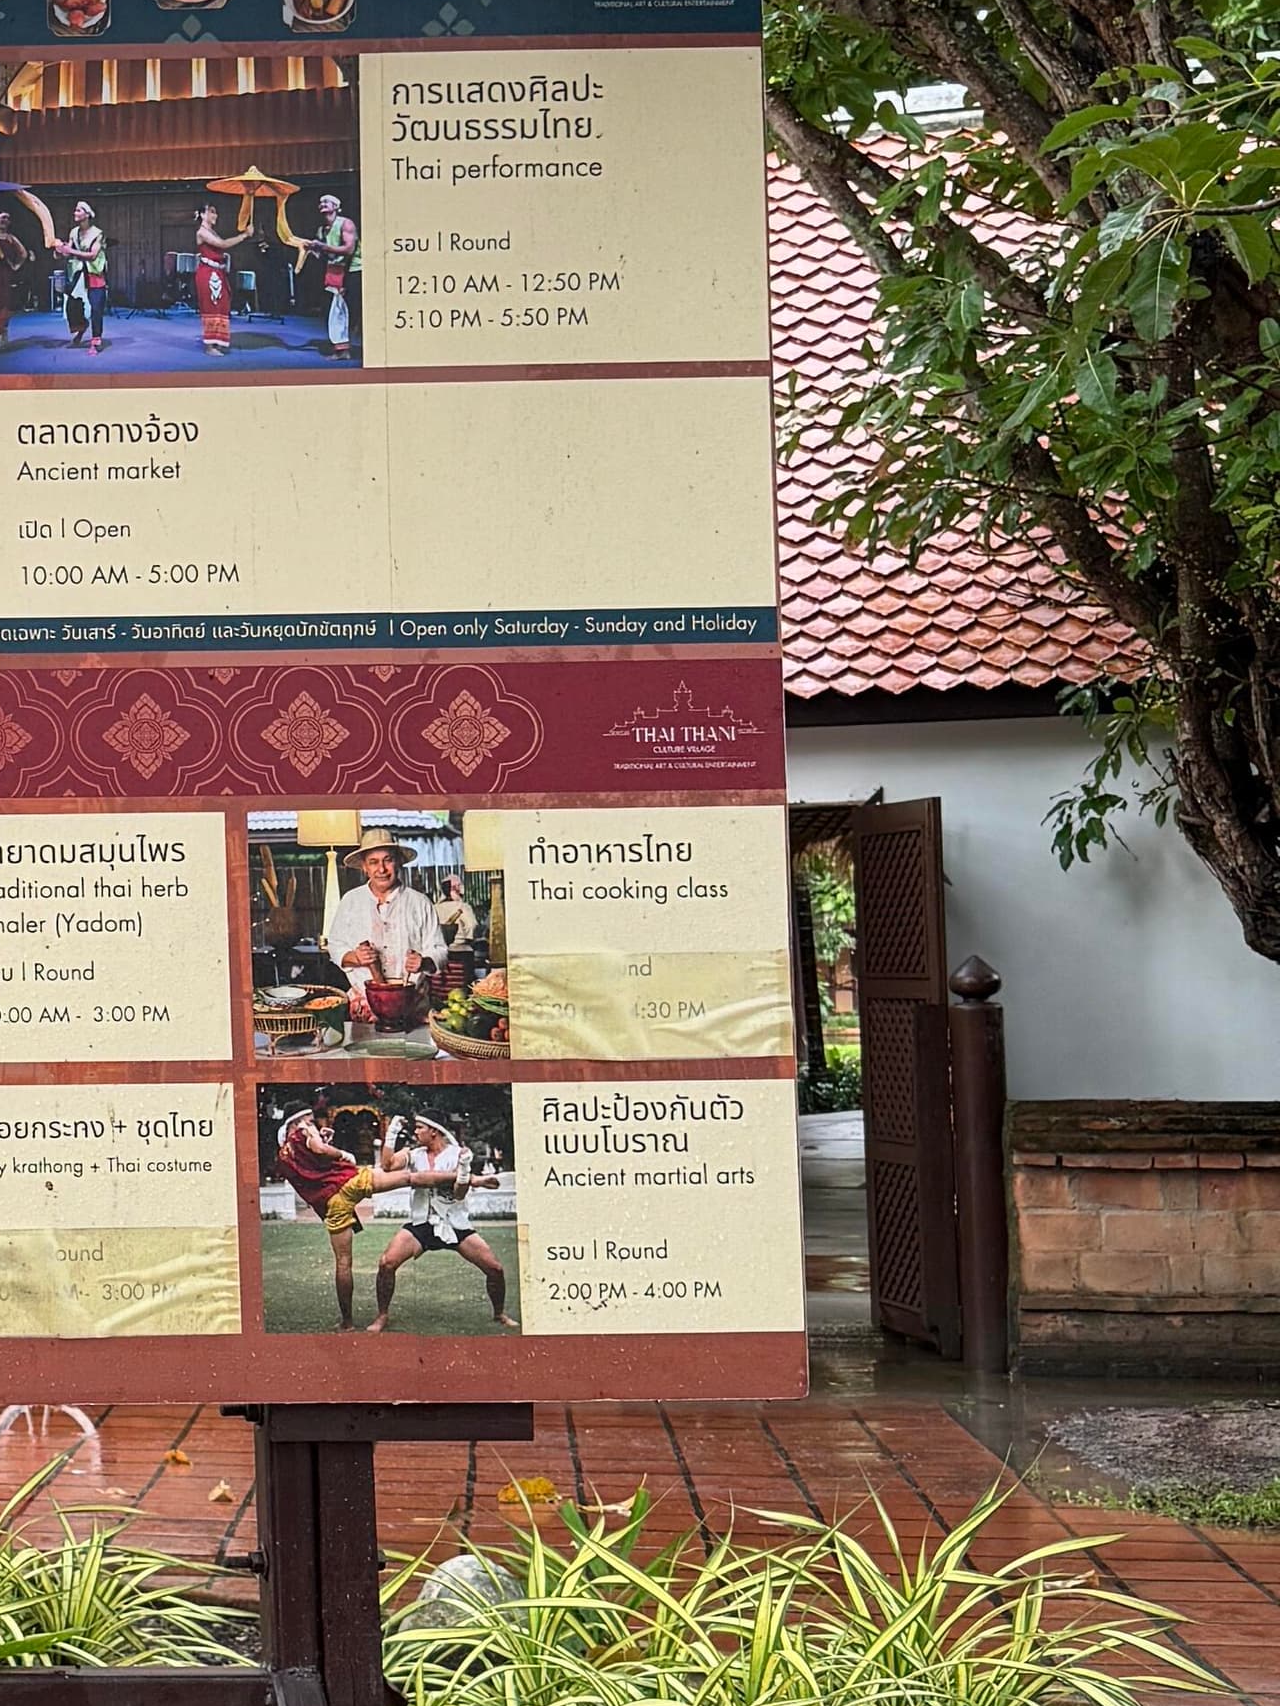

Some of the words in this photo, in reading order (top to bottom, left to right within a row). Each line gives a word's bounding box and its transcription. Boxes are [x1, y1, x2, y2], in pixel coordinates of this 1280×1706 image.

[393, 73, 603, 105] การแสดงศิลปะ
[392, 108, 591, 141] วัฒนธรรมไทย
[391, 156, 440, 180] Thai
[453, 154, 602, 186] performance
[18, 414, 198, 444] ตลาดกางจ้อง
[17, 461, 98, 480] Ancient
[108, 457, 180, 479] market
[62, 624, 116, 640] วันเสาร์
[132, 624, 204, 638] วันอาทิตย์
[401, 620, 446, 640] Open
[453, 618, 488, 639] only
[495, 617, 568, 637] Saturday
[586, 615, 647, 636] Sunday
[654, 615, 685, 631] and
[692, 613, 757, 635] Holiday
[632, 727, 674, 742] THAI
[681, 726, 735, 741] THANI
[529, 834, 691, 864] ทำอาหารไทย
[94, 877, 131, 897] thai
[142, 876, 188, 897] herb
[528, 879, 573, 900] Thai
[583, 877, 667, 904] cooking
[677, 877, 728, 898] class
[56, 911, 141, 938] (Yadom)
[544, 1093, 743, 1122] ศิลปะป้องกันตัว
[137, 1112, 212, 1145] ชุดไทย
[545, 1125, 688, 1154] แบบโบราณ
[13, 1157, 83, 1177] krathong
[107, 1157, 140, 1172] Thai
[147, 1159, 212, 1172] costume
[545, 1167, 625, 1186] Ancient
[635, 1163, 707, 1185] martial
[717, 1167, 754, 1184] arts
[547, 1246, 584, 1260] รอบ
[606, 1239, 667, 1261] Round
[549, 1283, 591, 1300] 2:00
[599, 1283, 626, 1298] PM
[644, 1282, 686, 1298] 4:00
[695, 1282, 721, 1297] PM
